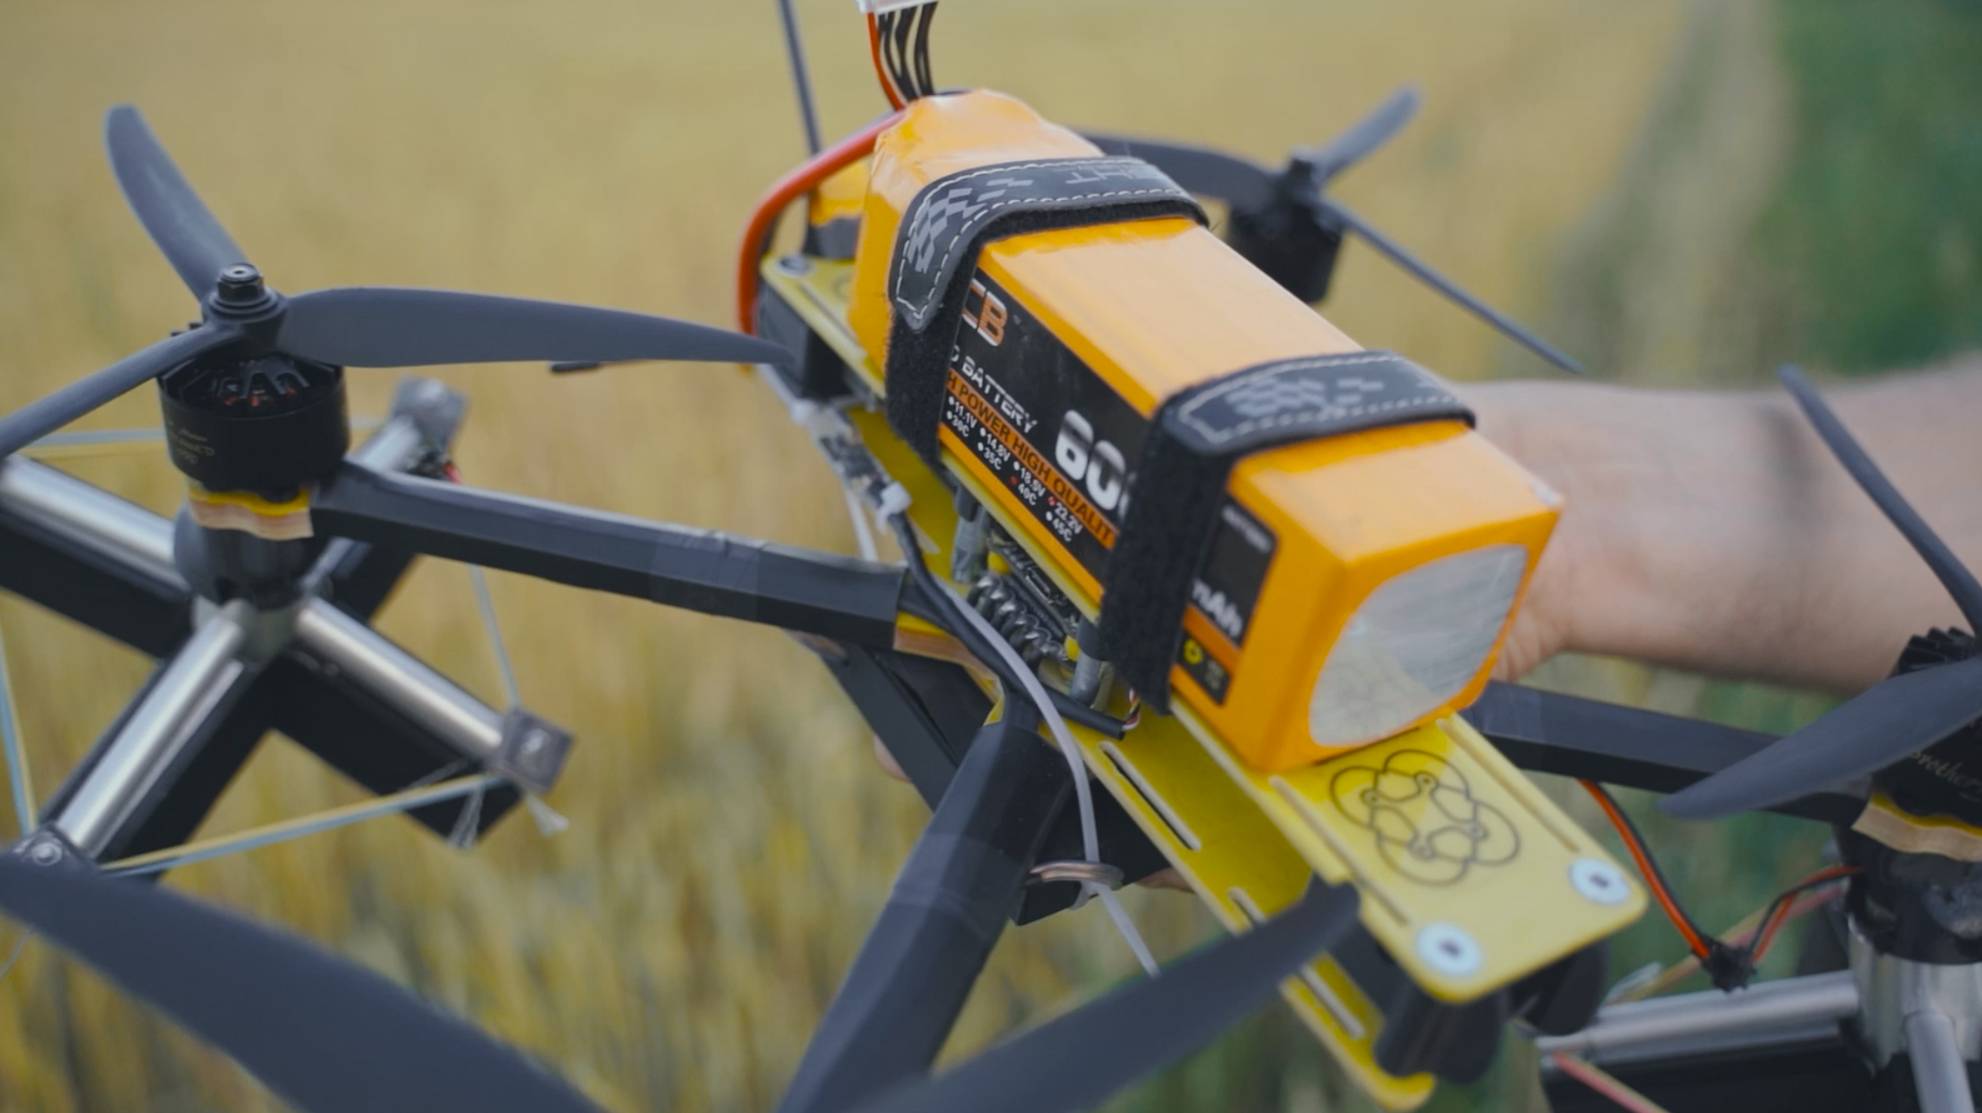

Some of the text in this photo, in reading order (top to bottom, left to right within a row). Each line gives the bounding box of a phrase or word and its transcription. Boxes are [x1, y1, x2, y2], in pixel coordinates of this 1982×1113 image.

[959, 381, 1010, 442] POWER
[1012, 436, 1051, 480] HIGH
[962, 356, 1037, 433] BATTERY
[1055, 410, 1137, 523] 60
